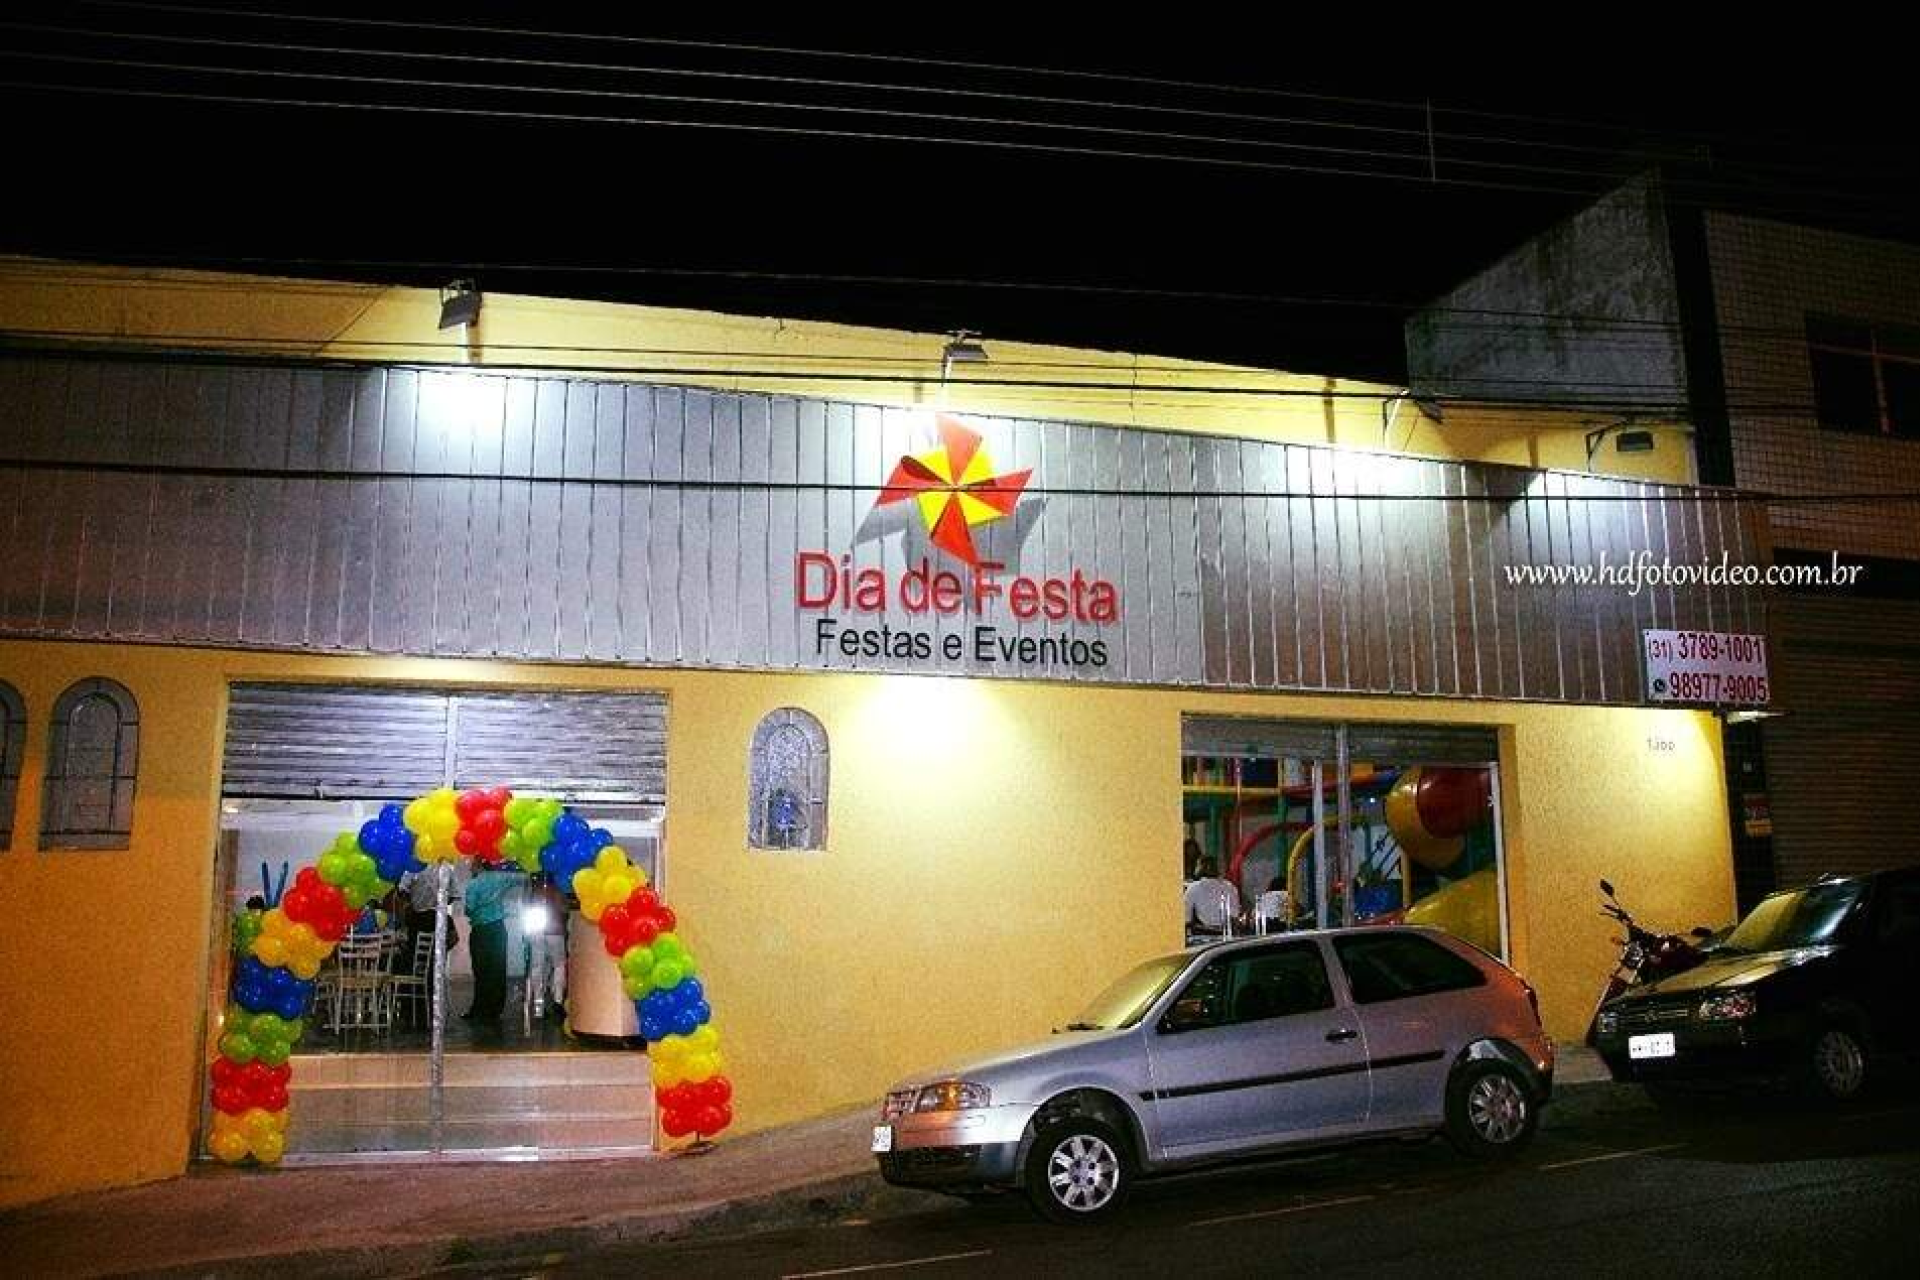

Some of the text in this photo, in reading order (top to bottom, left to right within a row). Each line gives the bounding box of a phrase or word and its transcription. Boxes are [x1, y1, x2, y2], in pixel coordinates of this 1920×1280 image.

[796, 551, 1118, 623] Dia de Festa
[816, 618, 1109, 667] Festas e Eventos
[1648, 632, 1763, 663] (31) 3789-1001
[1670, 671, 1767, 702] 98977-9005
